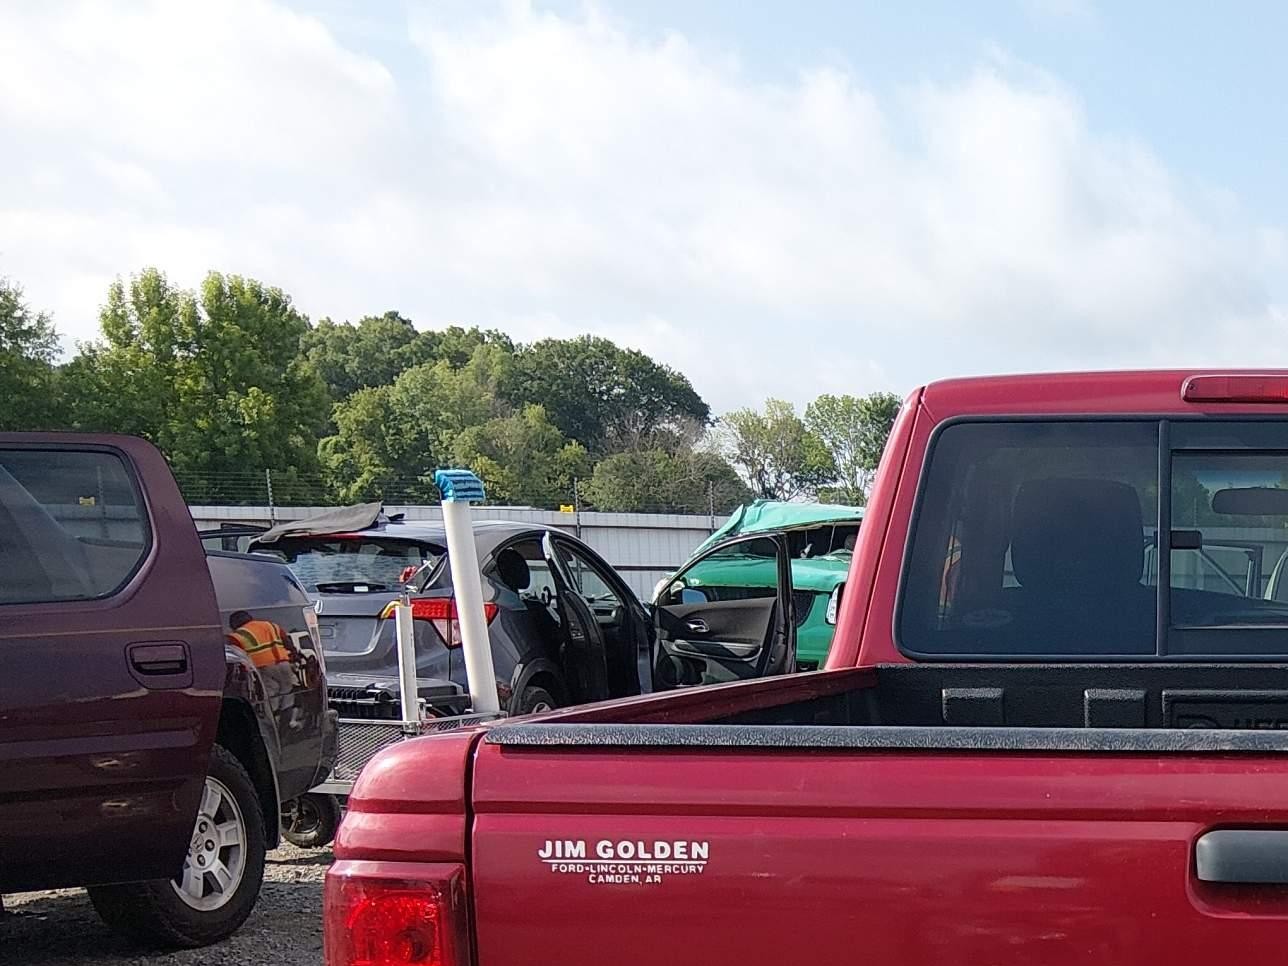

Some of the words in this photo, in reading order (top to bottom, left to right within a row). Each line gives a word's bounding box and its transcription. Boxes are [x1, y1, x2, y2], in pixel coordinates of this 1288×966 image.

[538, 840, 586, 858] JIM
[596, 840, 709, 859] GOLDEN
[645, 874, 662, 884] AR
